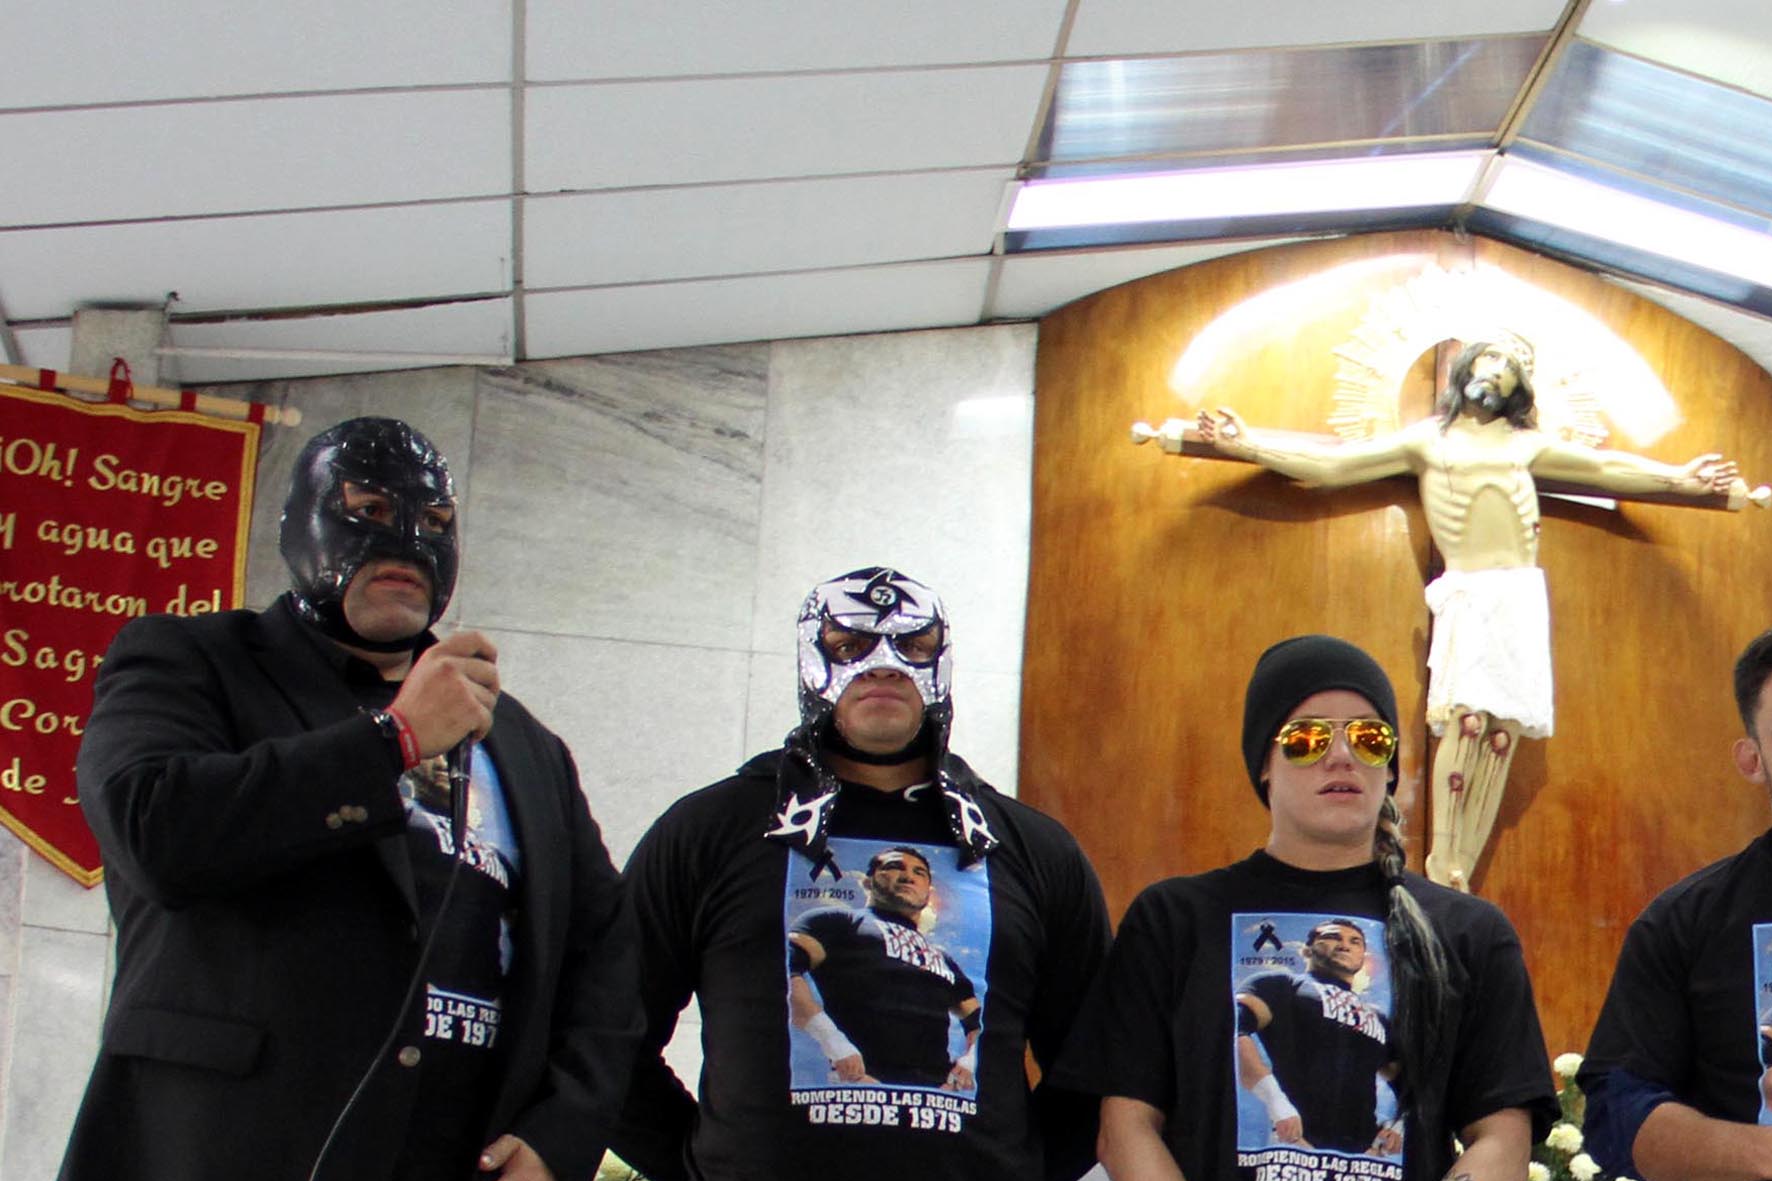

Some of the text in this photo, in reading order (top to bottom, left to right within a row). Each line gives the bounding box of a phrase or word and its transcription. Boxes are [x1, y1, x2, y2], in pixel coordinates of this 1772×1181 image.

[88, 454, 228, 507] Sangre
[38, 519, 136, 555] agua
[146, 536, 218, 568] que
[166, 583, 221, 616] del
[1, 757, 47, 794] de
[794, 888, 820, 899] 1979
[829, 888, 855, 900] 2015
[447, 1000, 476, 1019] LAS
[791, 1090, 977, 1115] ROMPIENDO LAS REGLAS
[809, 1104, 962, 1133] DESDE 1979
[1238, 1151, 1403, 1181] ROMPIENDO LAS REGLAS
